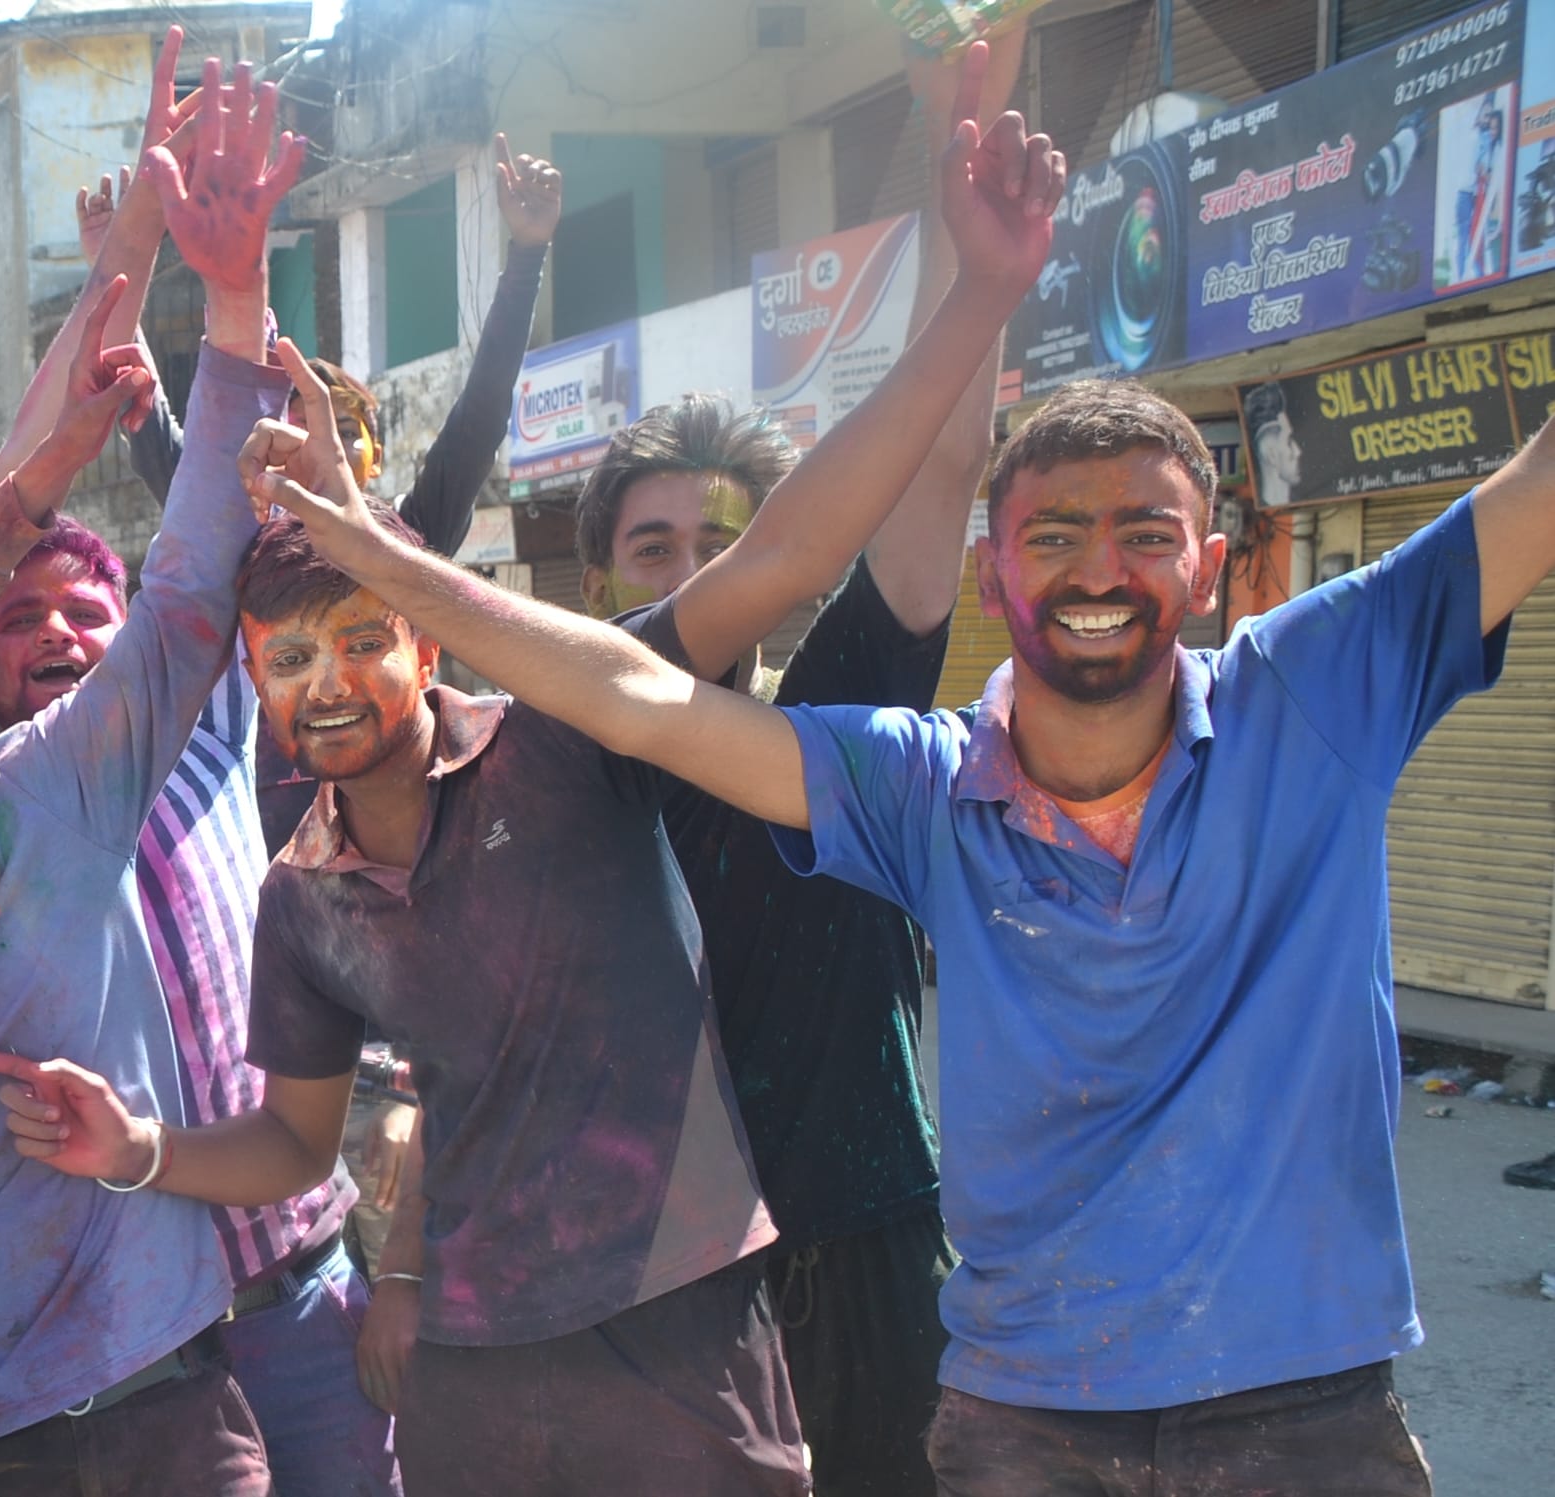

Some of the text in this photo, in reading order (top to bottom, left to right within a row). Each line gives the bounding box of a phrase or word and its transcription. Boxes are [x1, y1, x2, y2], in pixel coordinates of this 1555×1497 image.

[1396, 2, 1511, 68] 9720949096
[1394, 40, 1508, 106] 8279614727
[757, 251, 804, 331] दुर्गा
[523, 380, 583, 418] MICROTEK
[1316, 343, 1499, 420] SILVI HAIR
[556, 420, 584, 439] SOLAR
[1350, 405, 1478, 463] DRESSER
